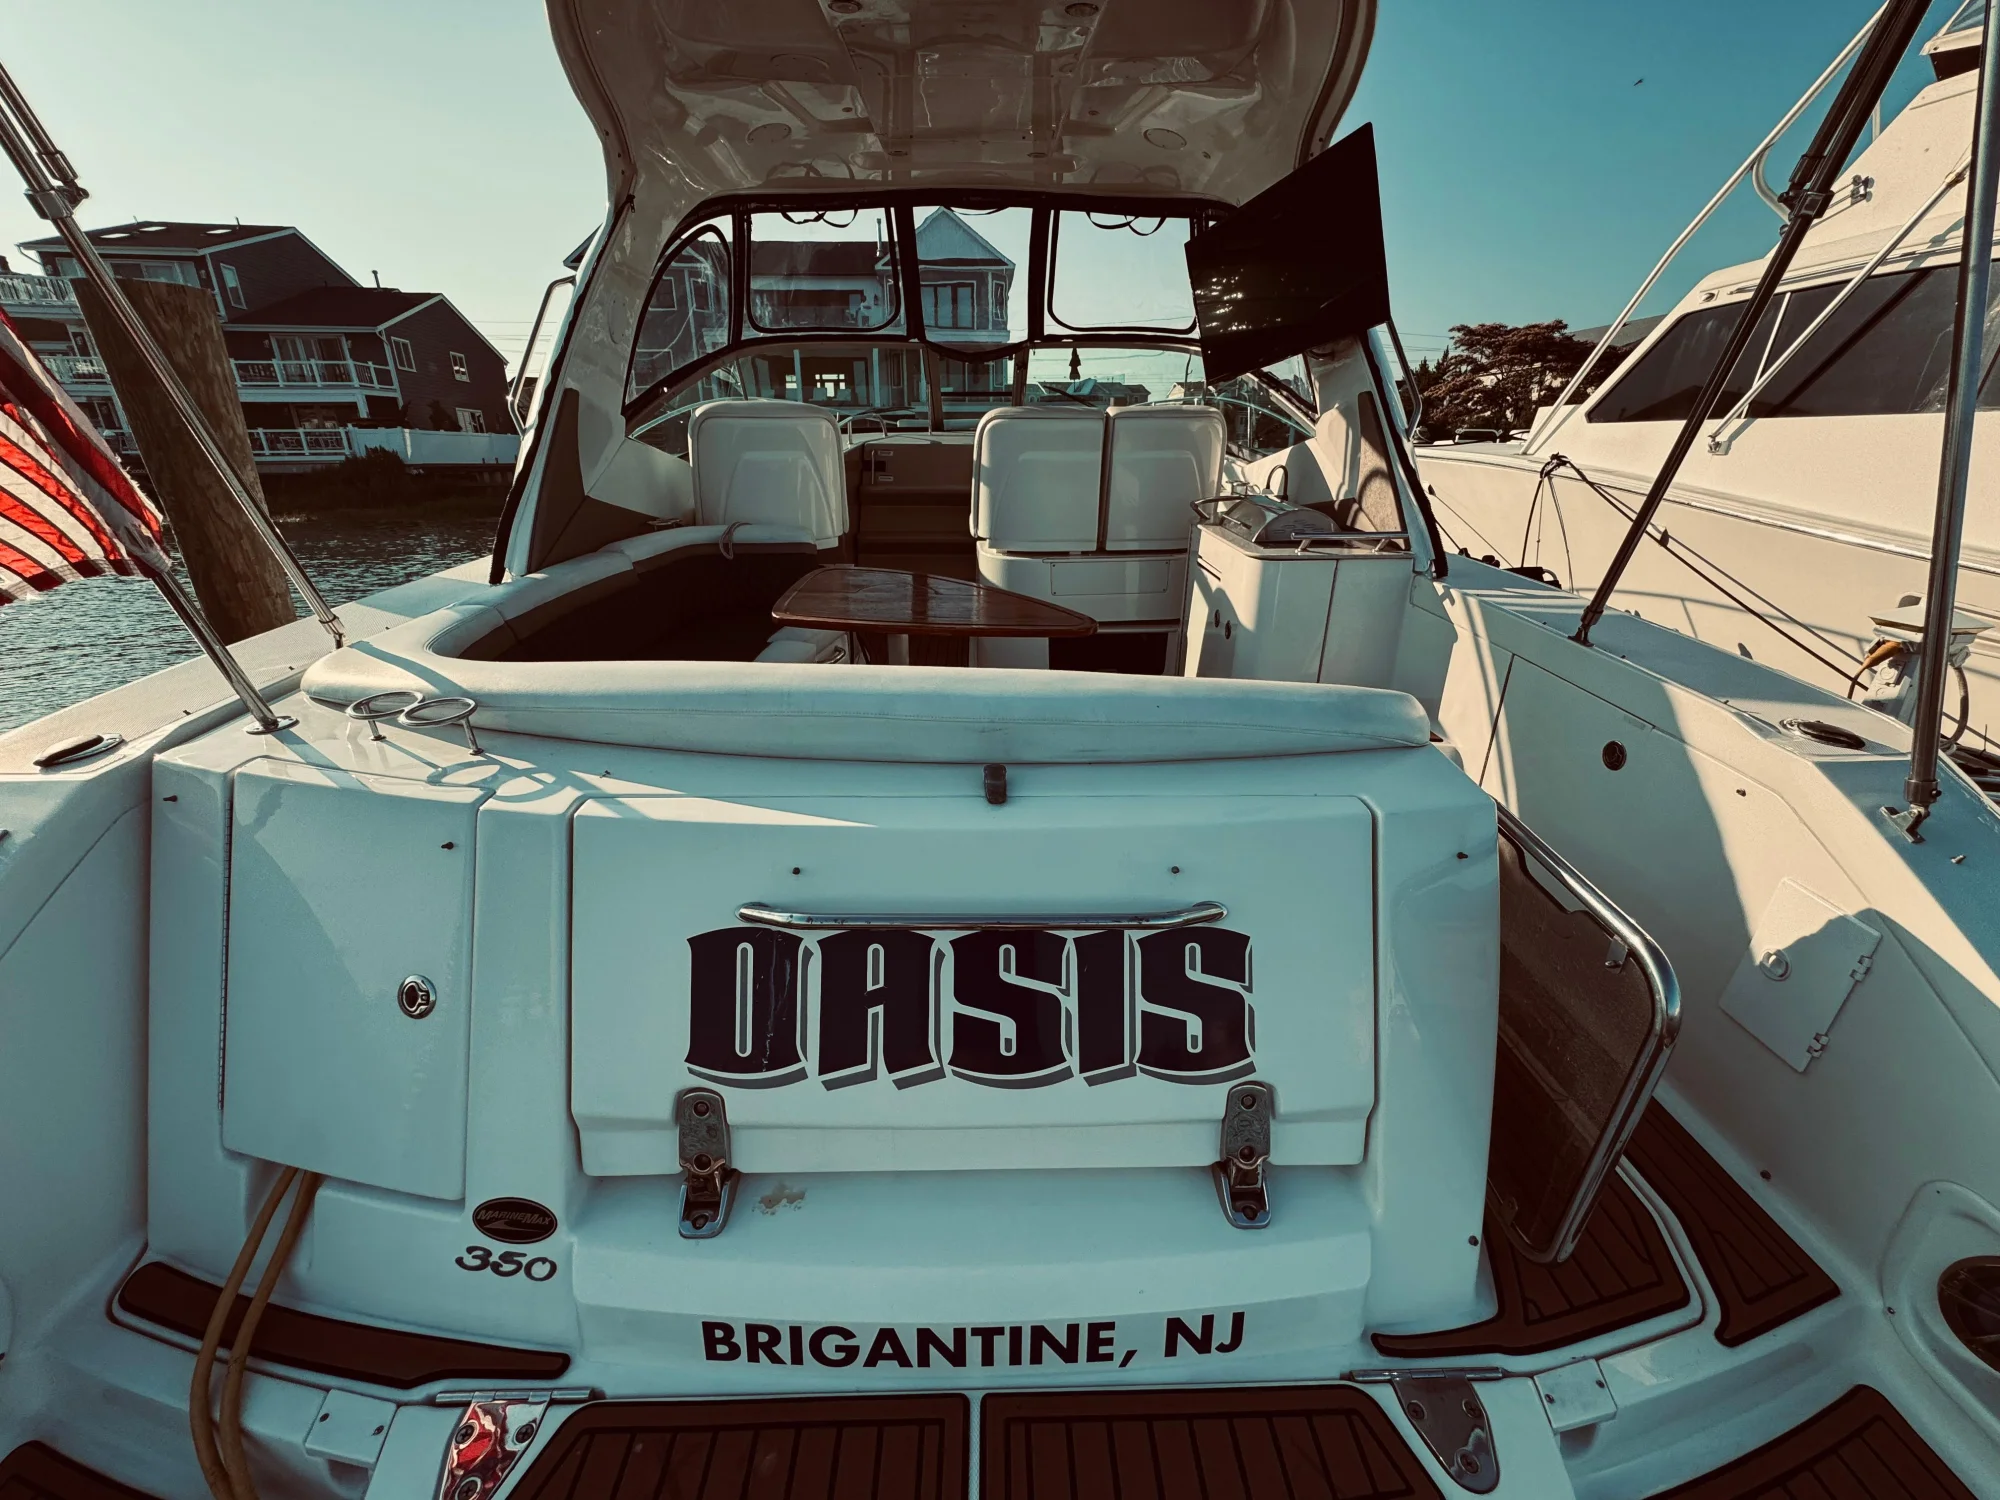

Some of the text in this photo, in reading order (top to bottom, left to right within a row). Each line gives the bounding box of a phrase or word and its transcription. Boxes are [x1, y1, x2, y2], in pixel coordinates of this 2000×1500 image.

[684, 926, 1257, 1091] OASIS
[454, 1245, 558, 1282] 350
[701, 1312, 1245, 1368] BRIGANTINE, NJ
